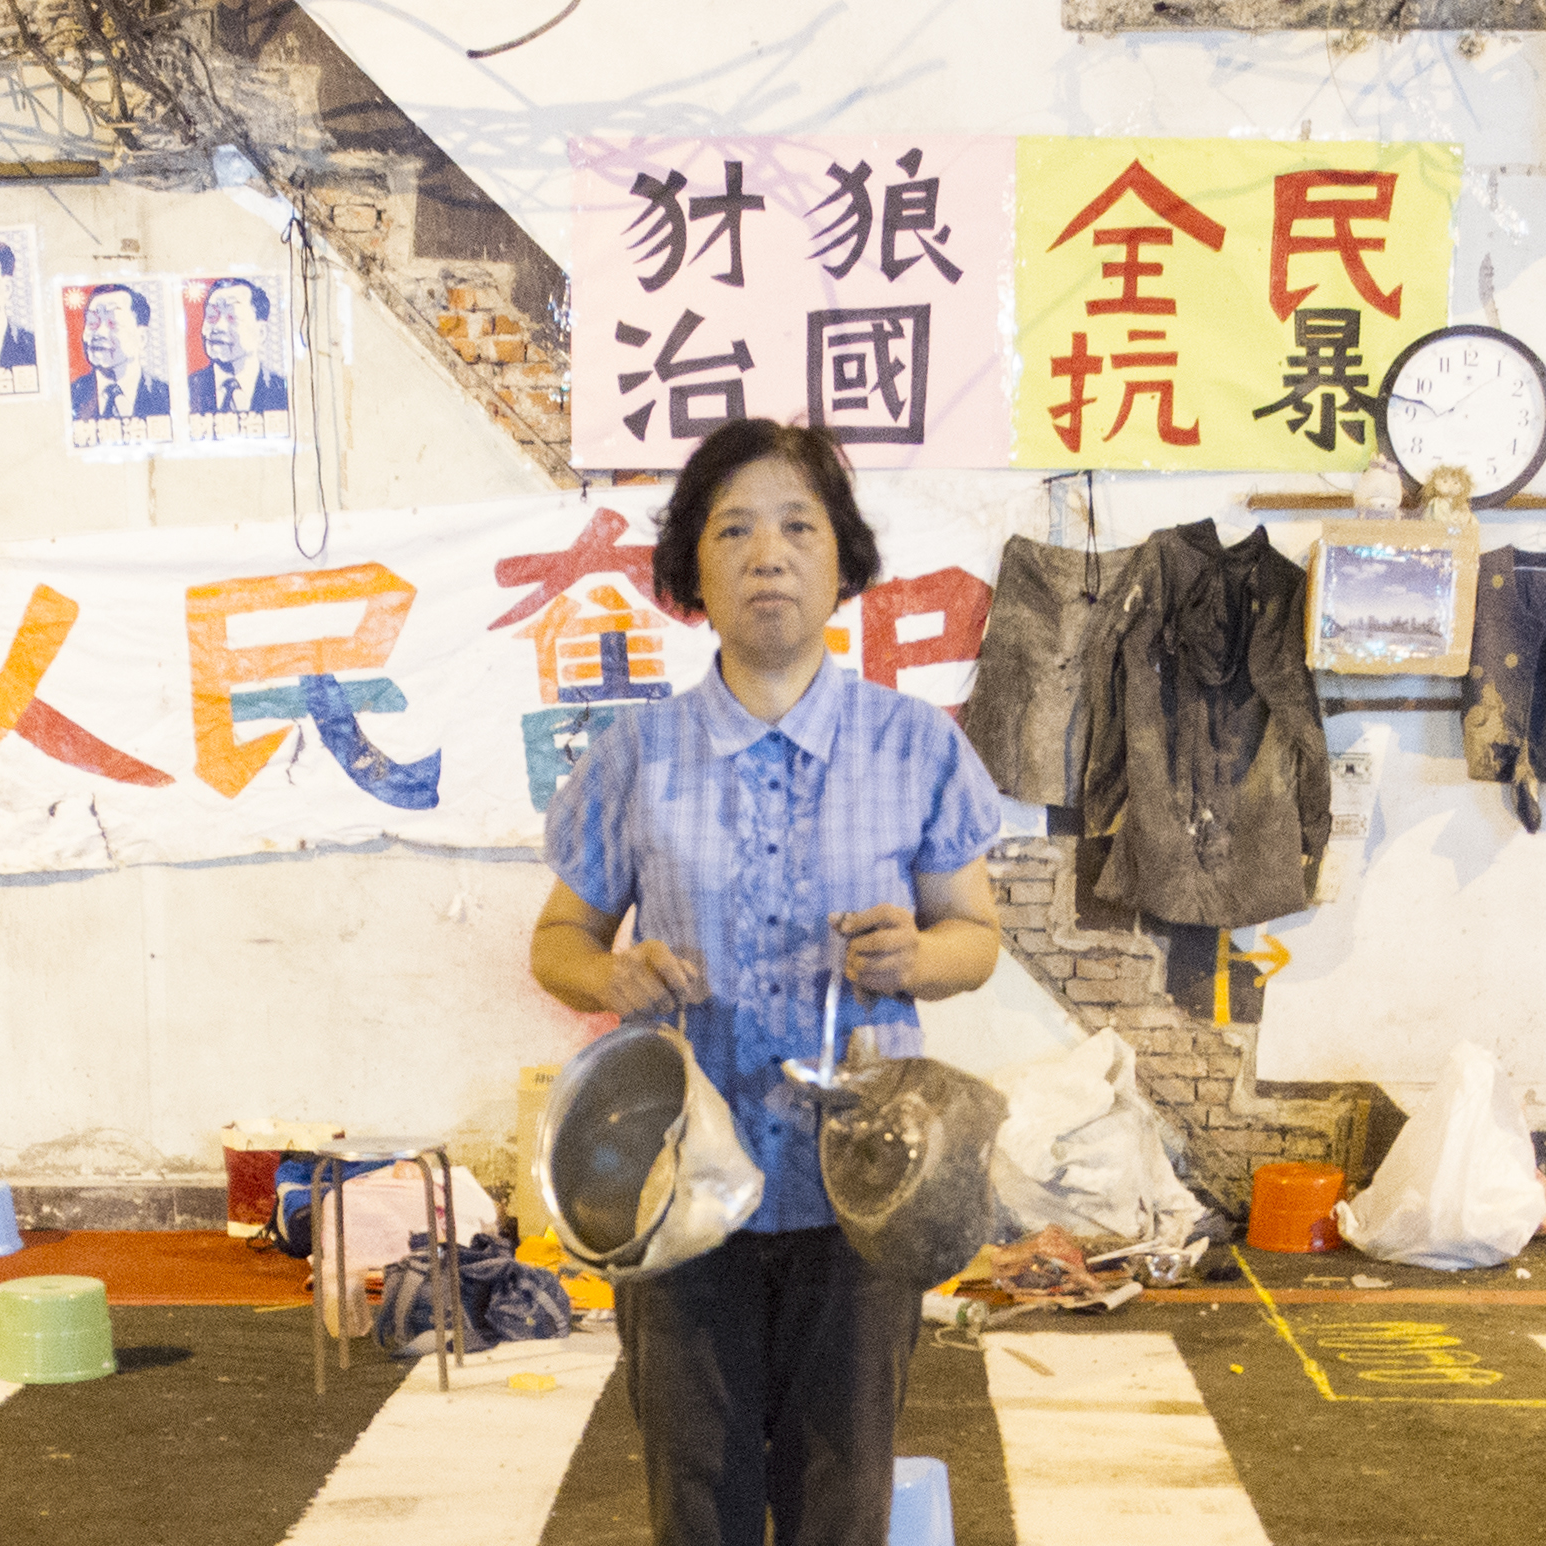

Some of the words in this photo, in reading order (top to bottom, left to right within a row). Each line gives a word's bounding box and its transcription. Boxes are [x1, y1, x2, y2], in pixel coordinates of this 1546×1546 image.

[1046, 158, 1404, 321] 全民
[615, 303, 931, 444] 治國
[1048, 309, 1380, 452] 抗暴
